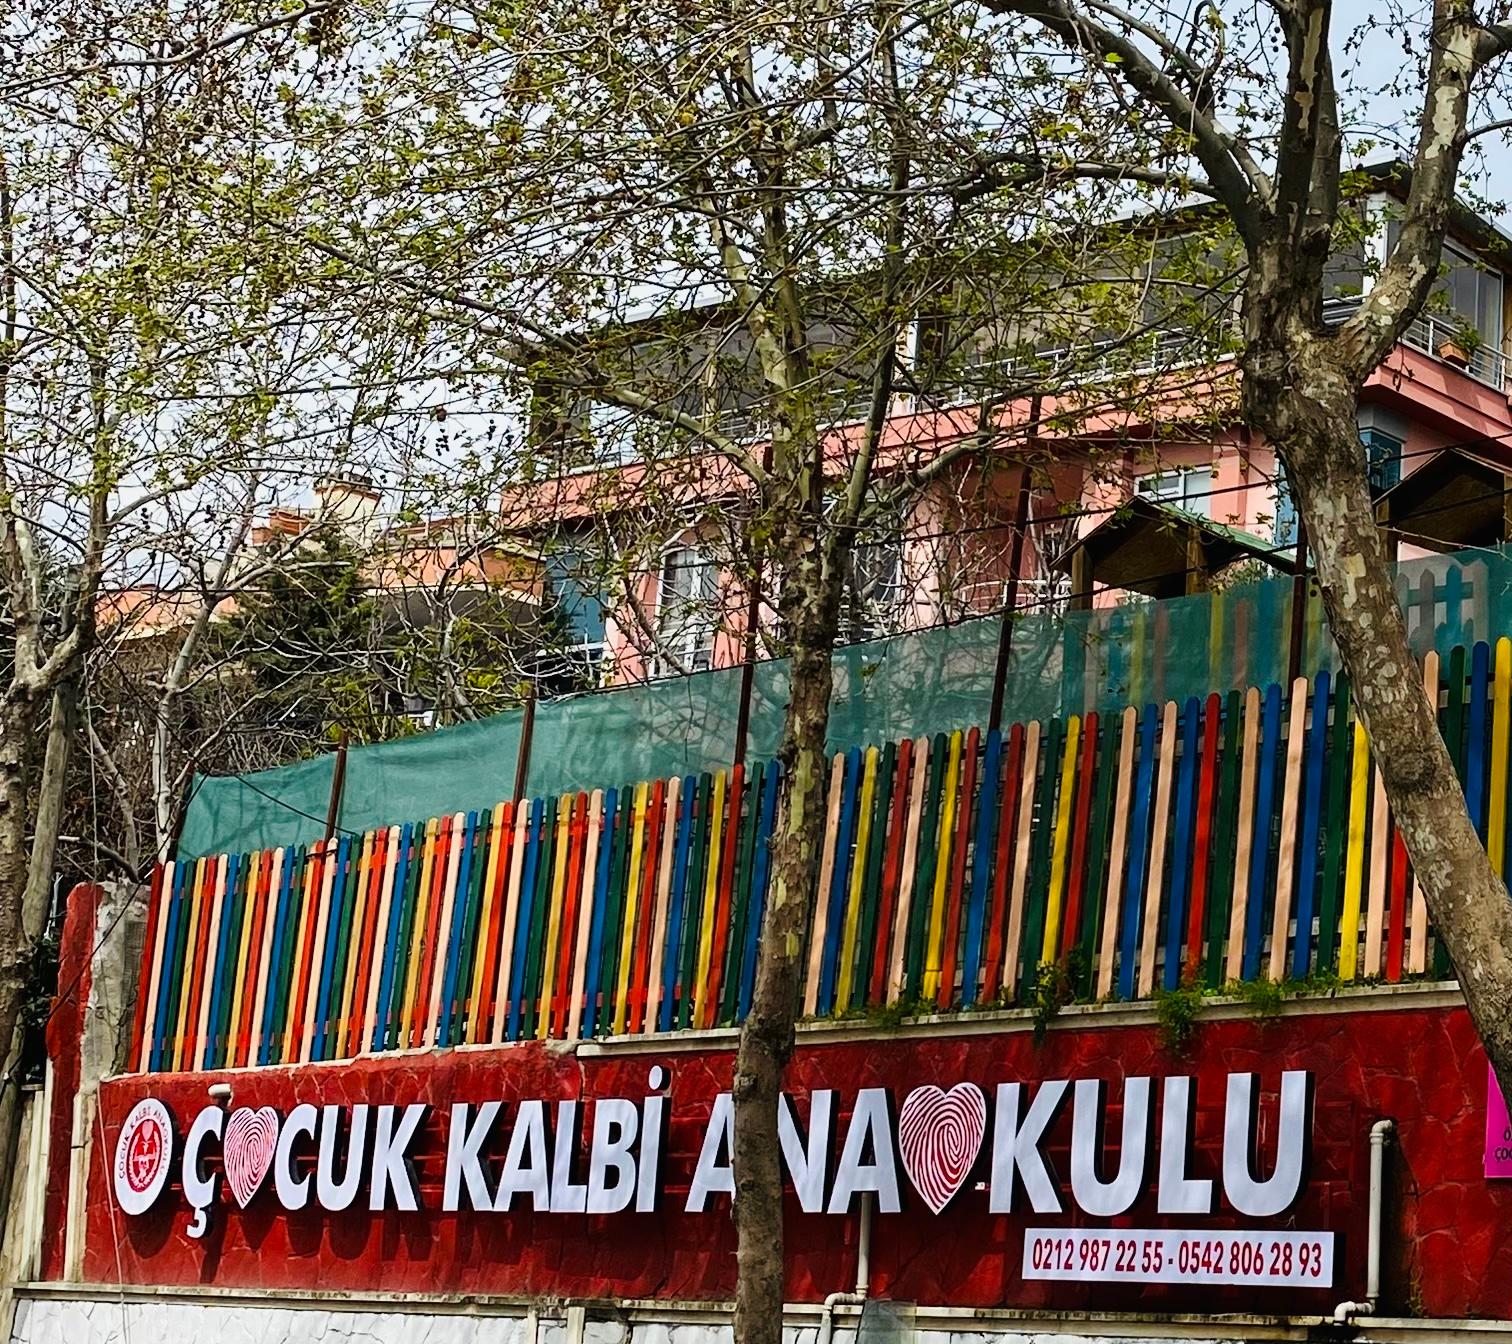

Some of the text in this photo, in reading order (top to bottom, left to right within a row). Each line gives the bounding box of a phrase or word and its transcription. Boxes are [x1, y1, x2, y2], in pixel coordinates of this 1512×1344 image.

[442, 1065, 670, 1213] KALBİ
[1032, 1238, 1074, 1270] 0212
[1079, 1239, 1111, 1271] 987
[1115, 1240, 1136, 1272] 22
[1142, 1240, 1163, 1273] 55
[1178, 1240, 1224, 1274] 0542
[1229, 1241, 1264, 1275] 806
[1269, 1241, 1293, 1276] 28
[1299, 1242, 1322, 1277] 93
